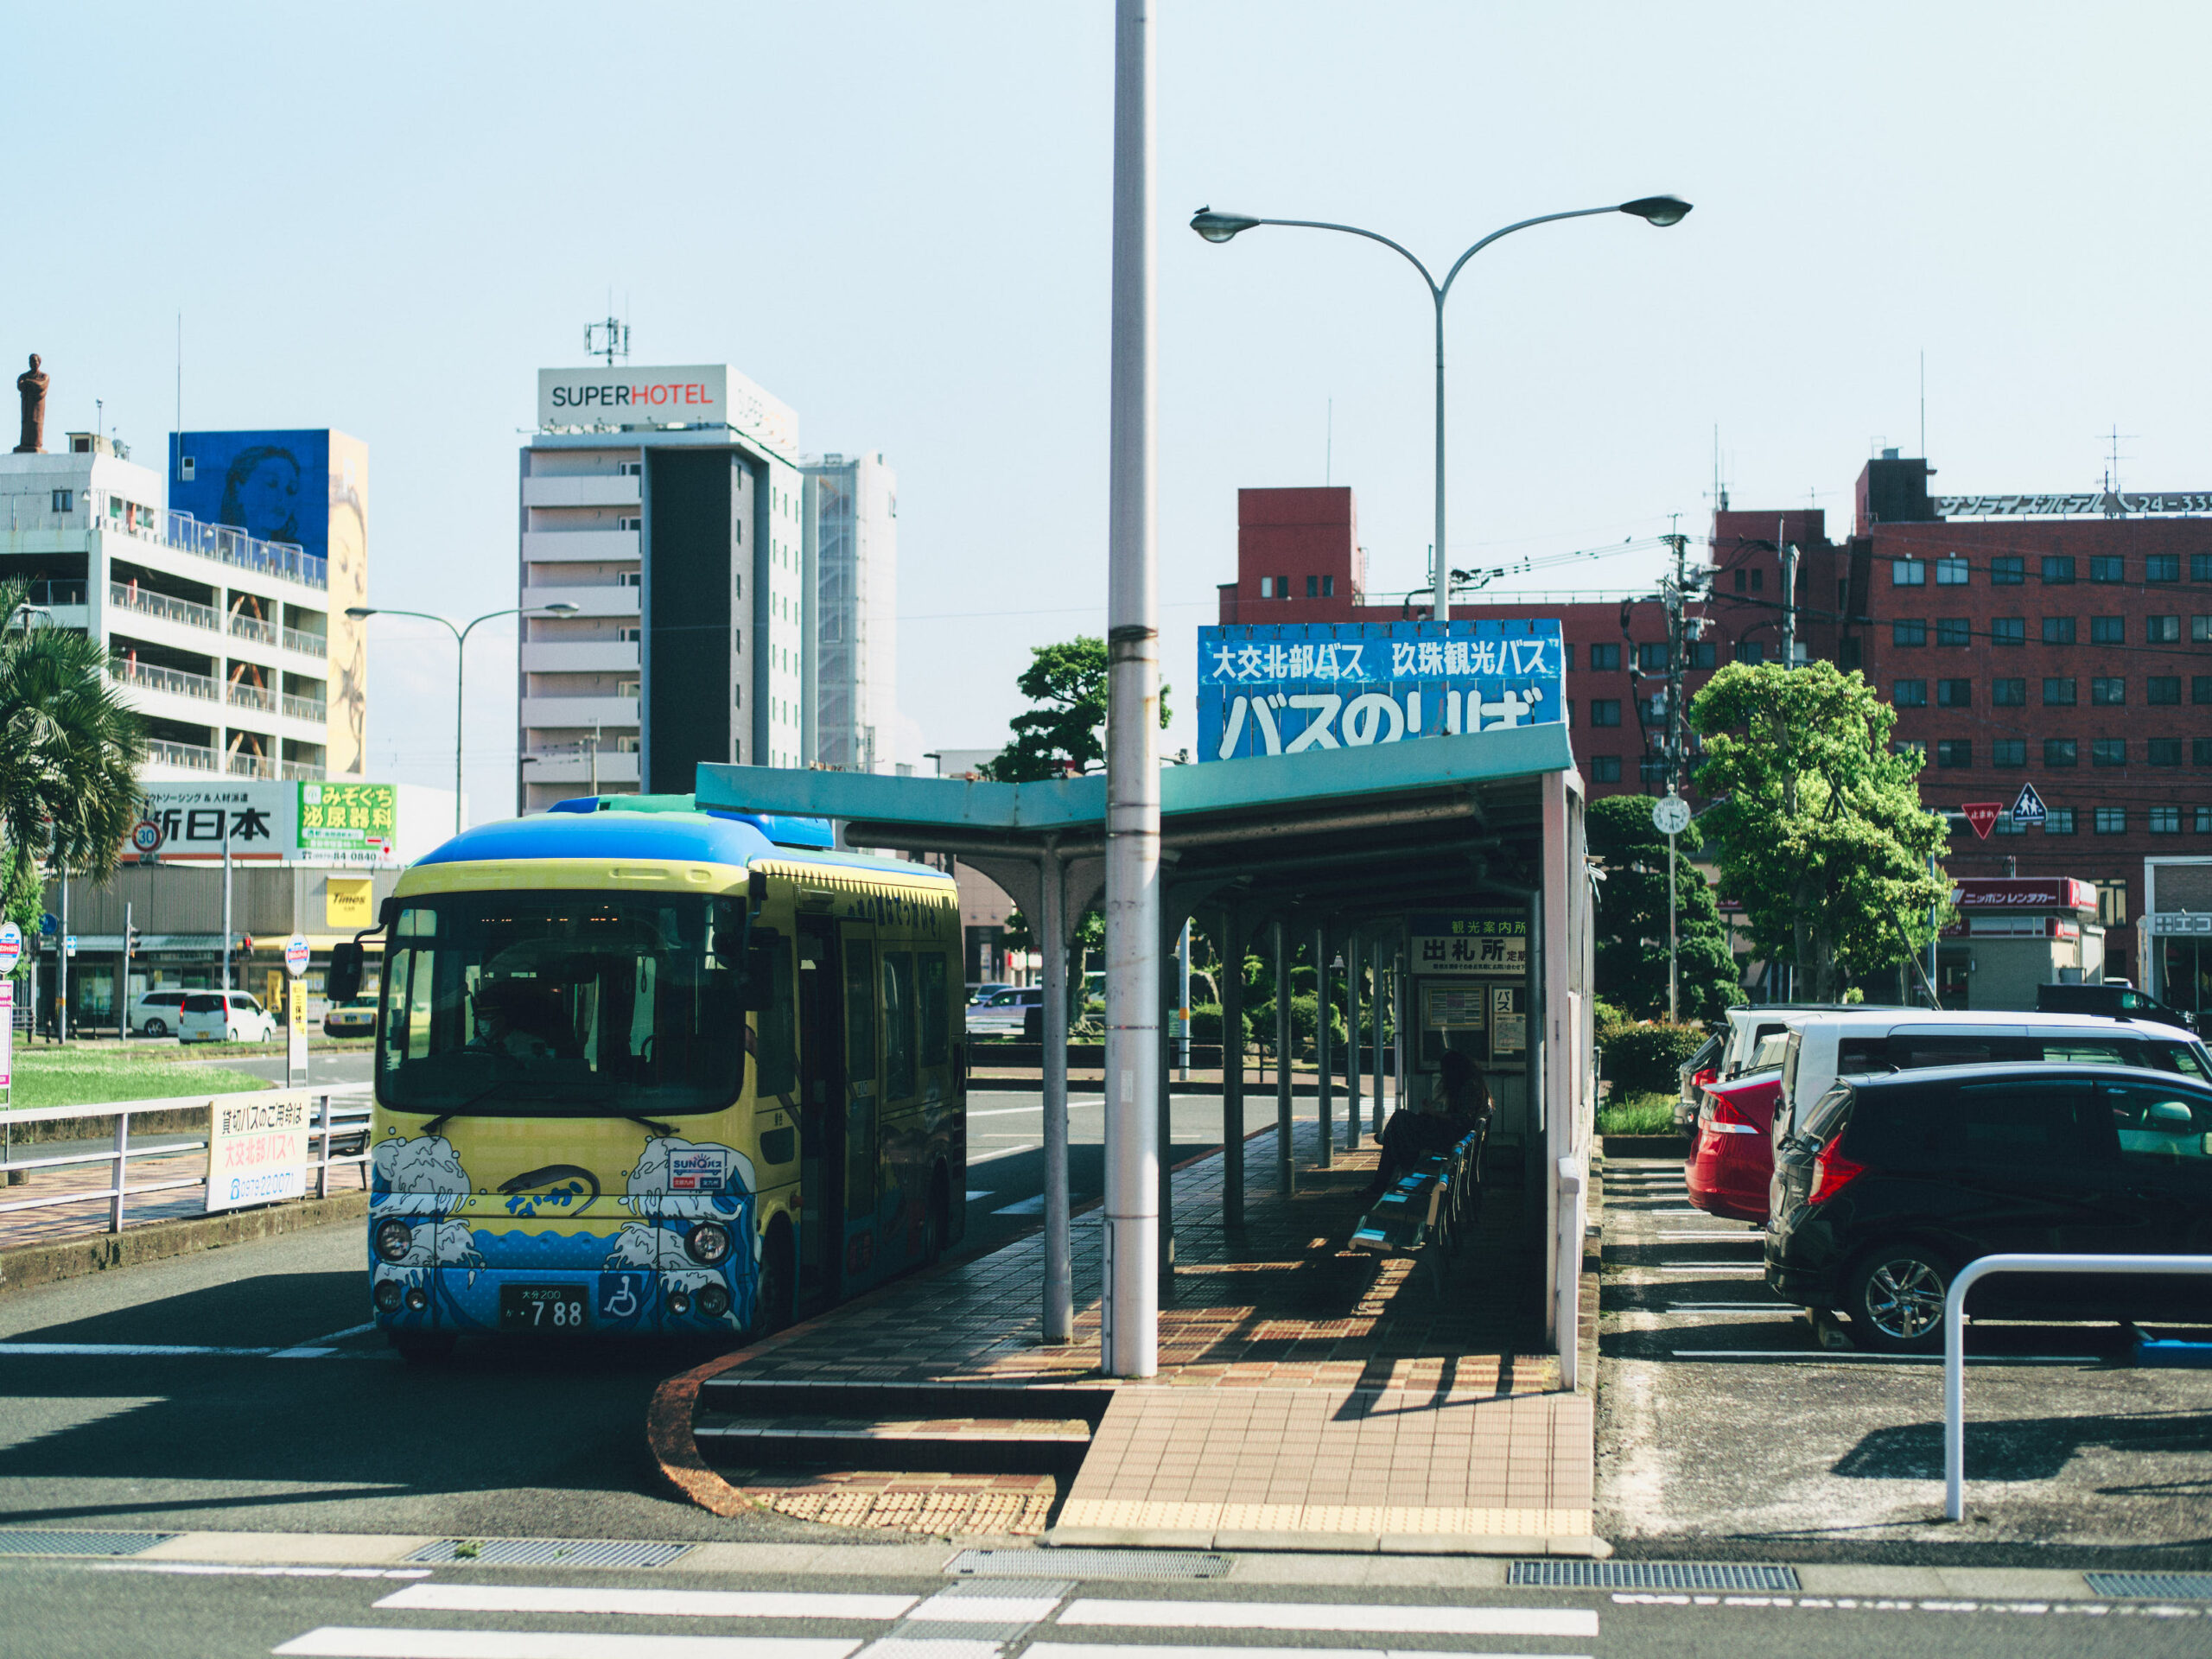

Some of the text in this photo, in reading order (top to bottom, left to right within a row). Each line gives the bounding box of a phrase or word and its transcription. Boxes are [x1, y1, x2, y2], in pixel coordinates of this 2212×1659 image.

[1211, 640, 1548, 679] 大交北部バス 玖珠観光バス
[1218, 686, 1544, 760] バスのりば
[321, 786, 393, 807] みぞぐち
[303, 805, 392, 830] 泌尿器科
[1971, 809, 1994, 820] 止まれ
[137, 829, 155, 844] 30
[334, 892, 366, 904] Times
[1452, 920, 1526, 934] 観光案内所
[1422, 938, 1505, 962] 出札所
[1497, 990, 1510, 1011] バス
[222, 1102, 302, 1135] 貸切バスのご用命は
[225, 1134, 296, 1169] 大交北部バスへ
